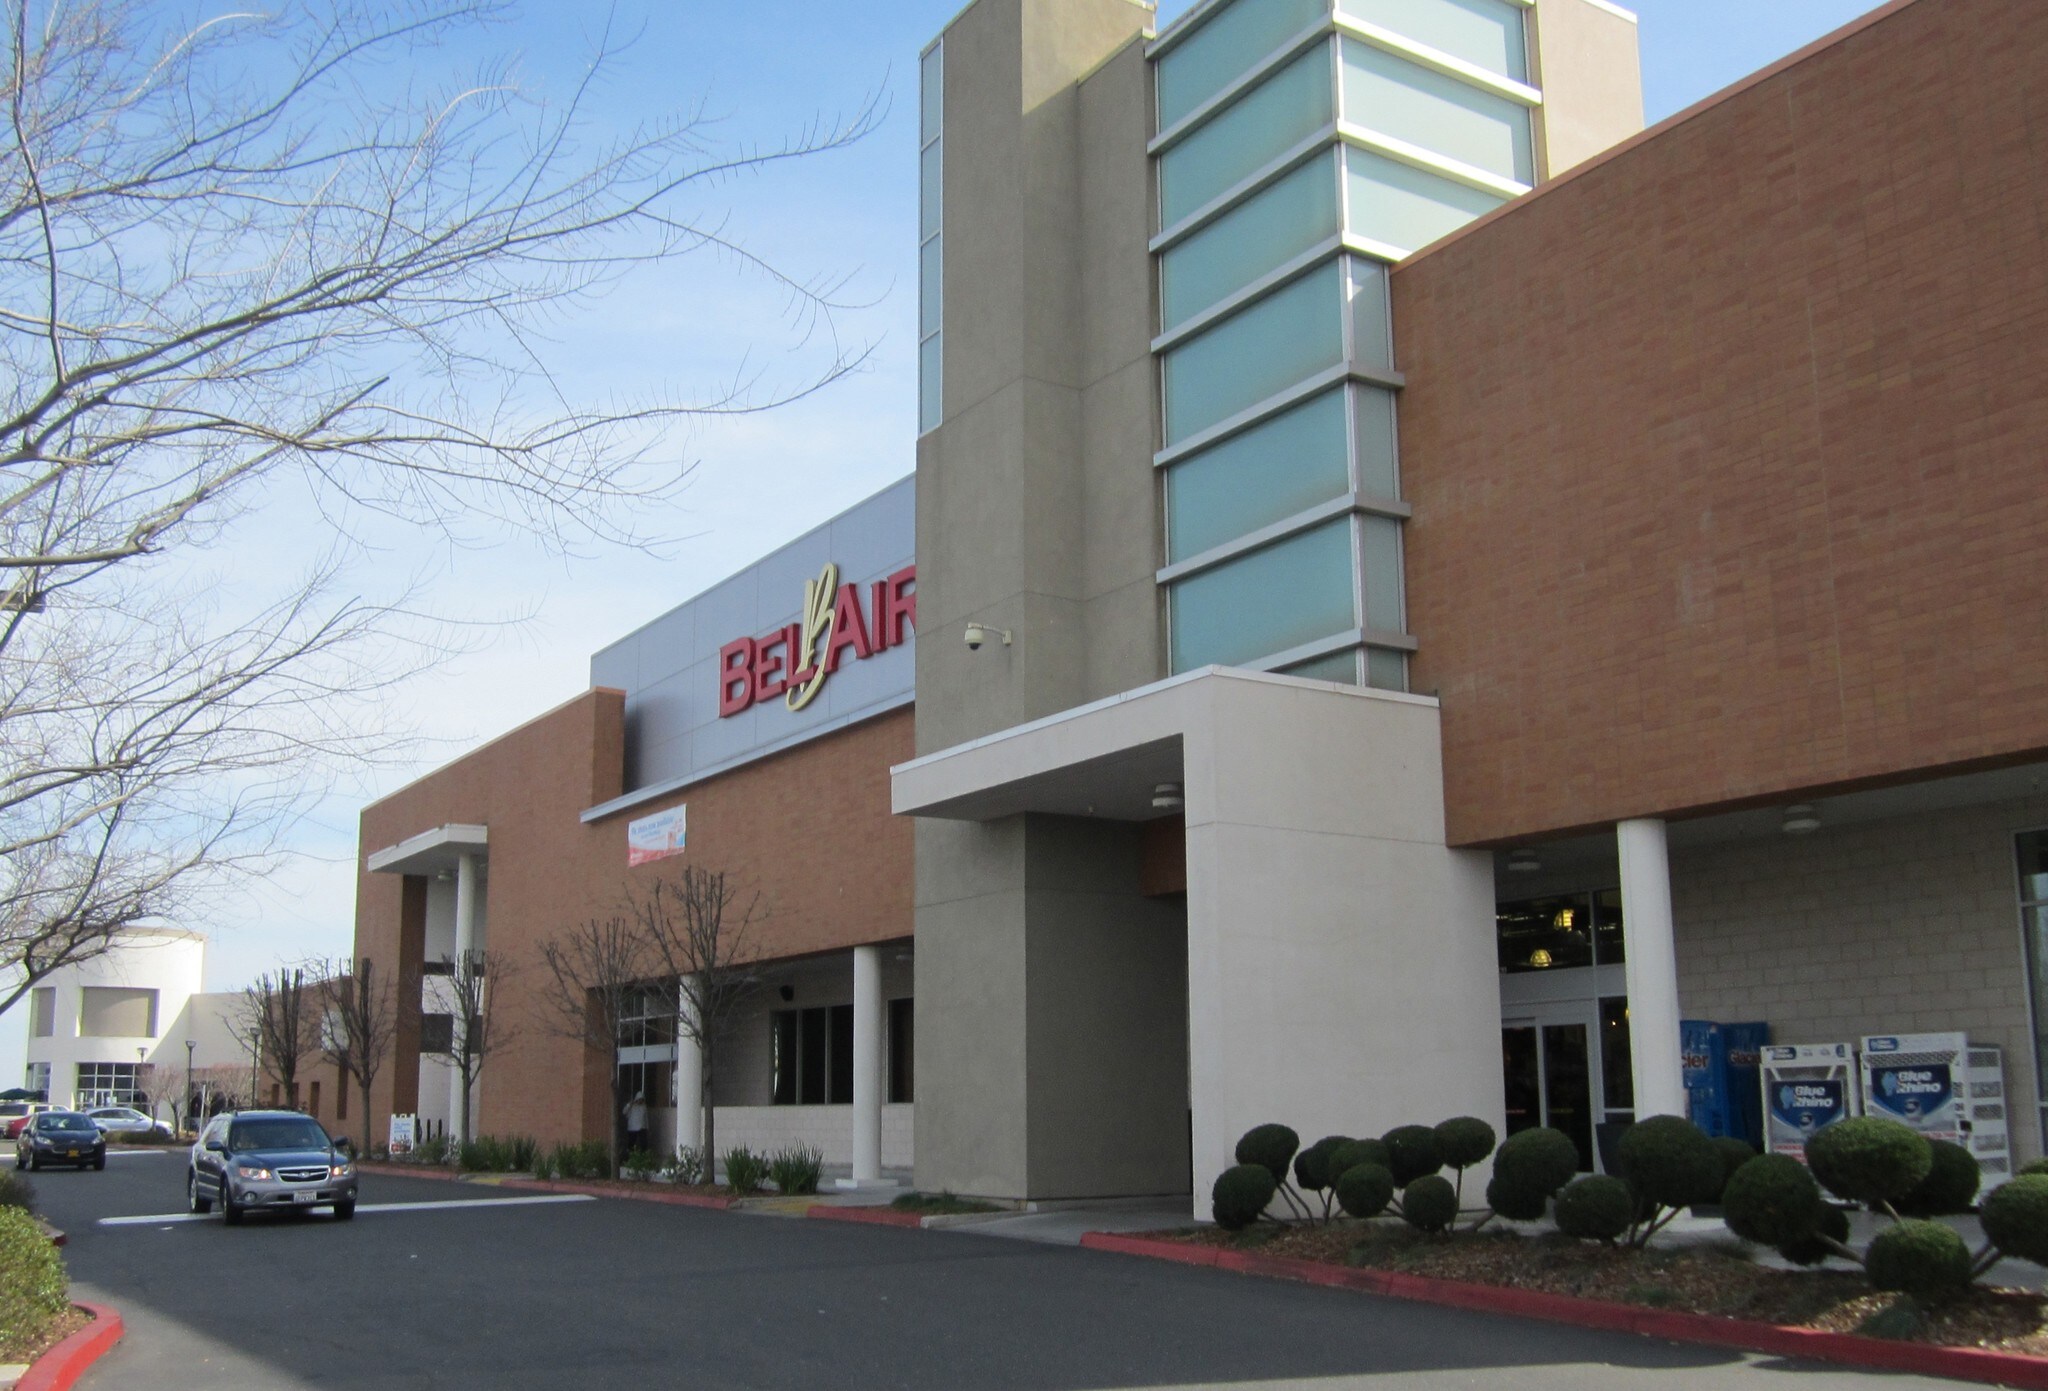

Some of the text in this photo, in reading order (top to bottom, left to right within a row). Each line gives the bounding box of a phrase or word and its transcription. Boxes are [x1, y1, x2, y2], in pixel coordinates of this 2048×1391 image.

[719, 564, 915, 718] BEL AIR
[1898, 1071, 1932, 1083] Blue
[1795, 1086, 1826, 1096] Blue
[1896, 1082, 1942, 1094] Rhino
[1793, 1096, 1834, 1107] Rhino
